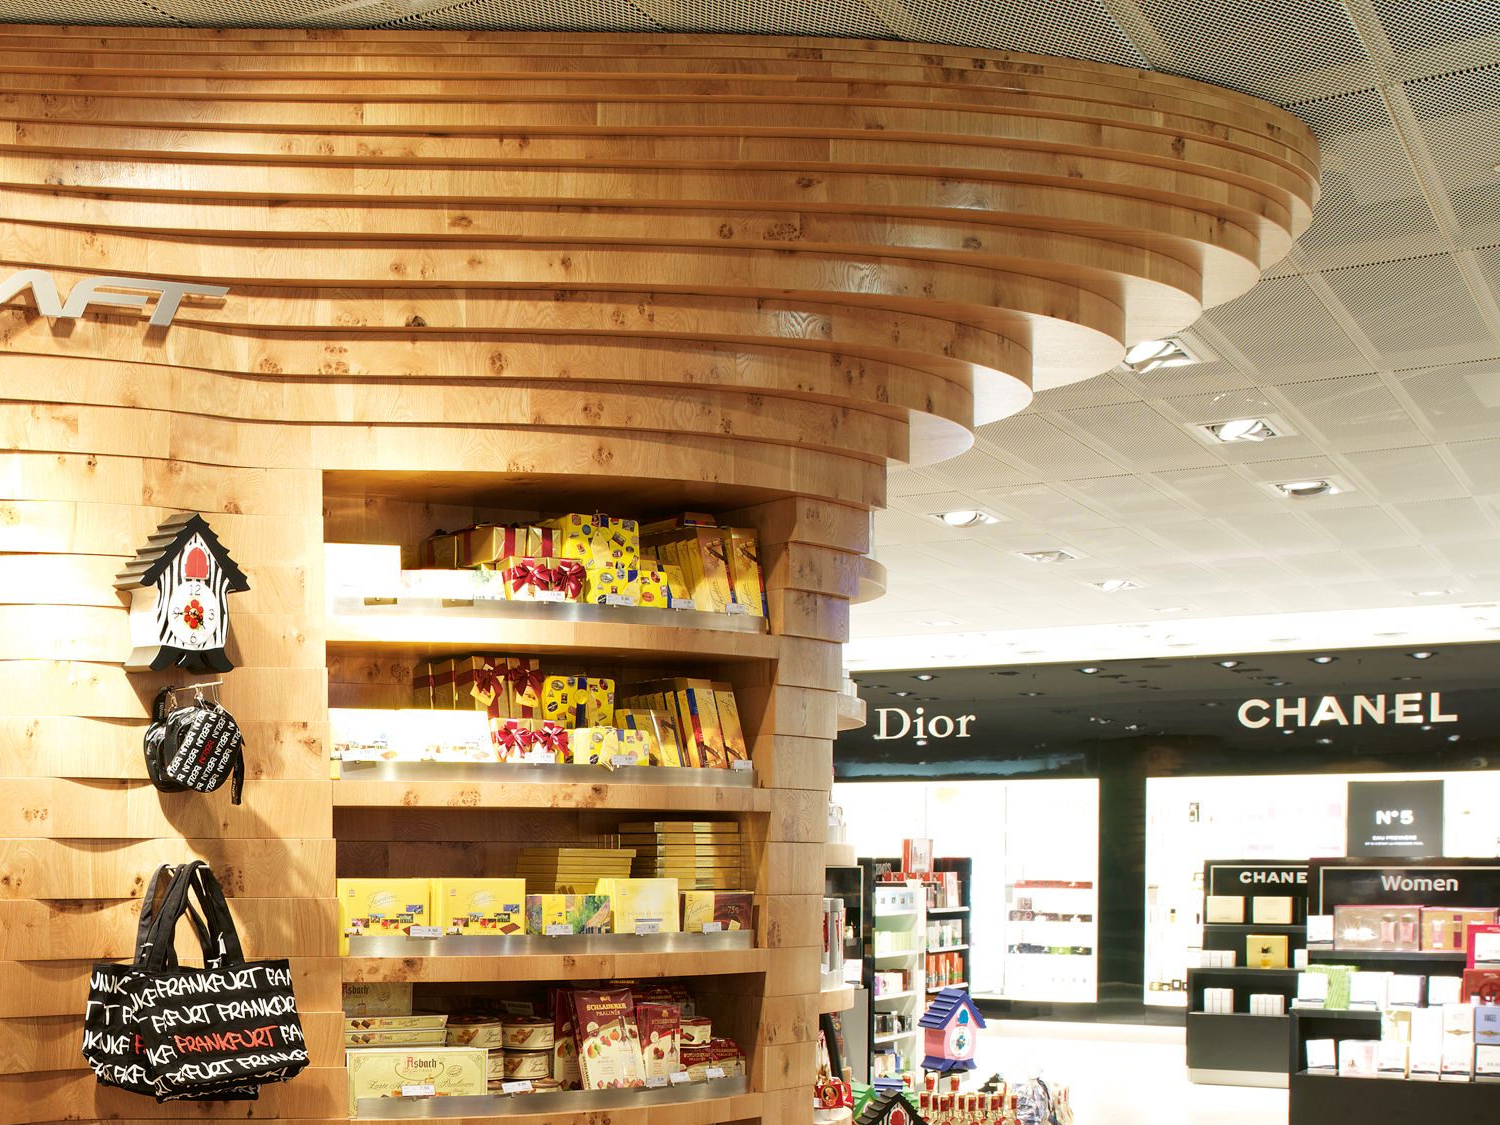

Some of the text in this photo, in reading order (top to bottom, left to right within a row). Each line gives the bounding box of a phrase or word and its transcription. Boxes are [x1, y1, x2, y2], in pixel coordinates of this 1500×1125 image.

[873, 706, 977, 740] Dior
[1237, 692, 1458, 728] CHANEL
[1239, 871, 1308, 885] CHANE
[1381, 875, 1459, 892] Women
[155, 966, 264, 999] FRANKFURT
[173, 1025, 278, 1055] FRANKFURT
[404, 1056, 438, 1073] Asbach
